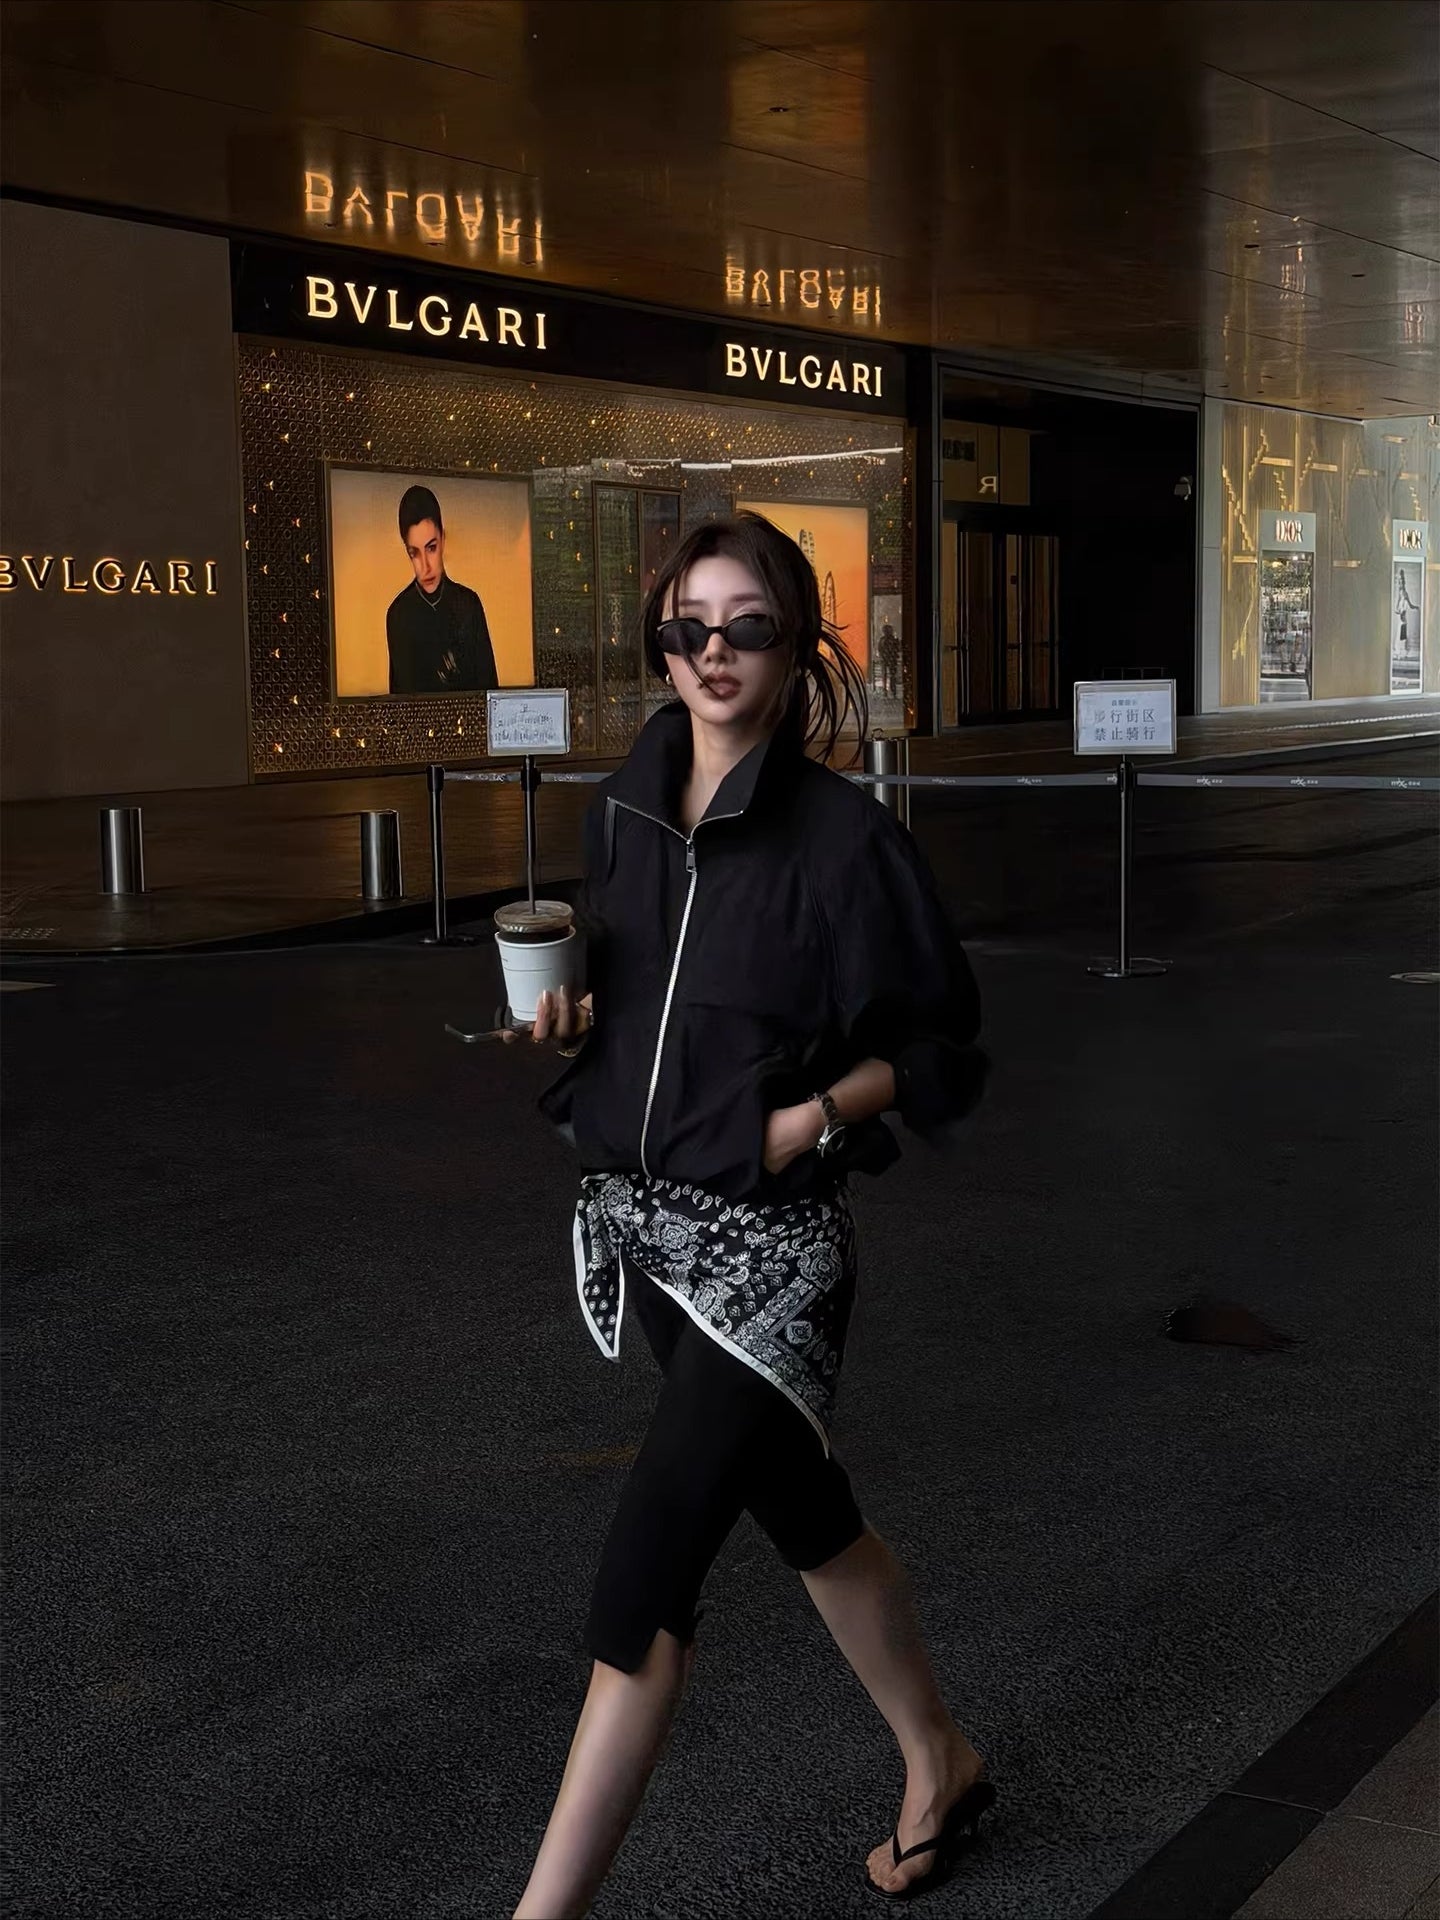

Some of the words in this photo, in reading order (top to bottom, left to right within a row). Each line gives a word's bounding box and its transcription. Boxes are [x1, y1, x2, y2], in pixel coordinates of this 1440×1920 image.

[306, 275, 547, 349] BVLGARI
[725, 343, 882, 397] BVLGARI
[1275, 519, 1303, 543] DIOR
[1400, 528, 1422, 549] DIOR
[0, 555, 218, 595] BVLGARI
[1095, 726, 1155, 741] 禁止骑行
